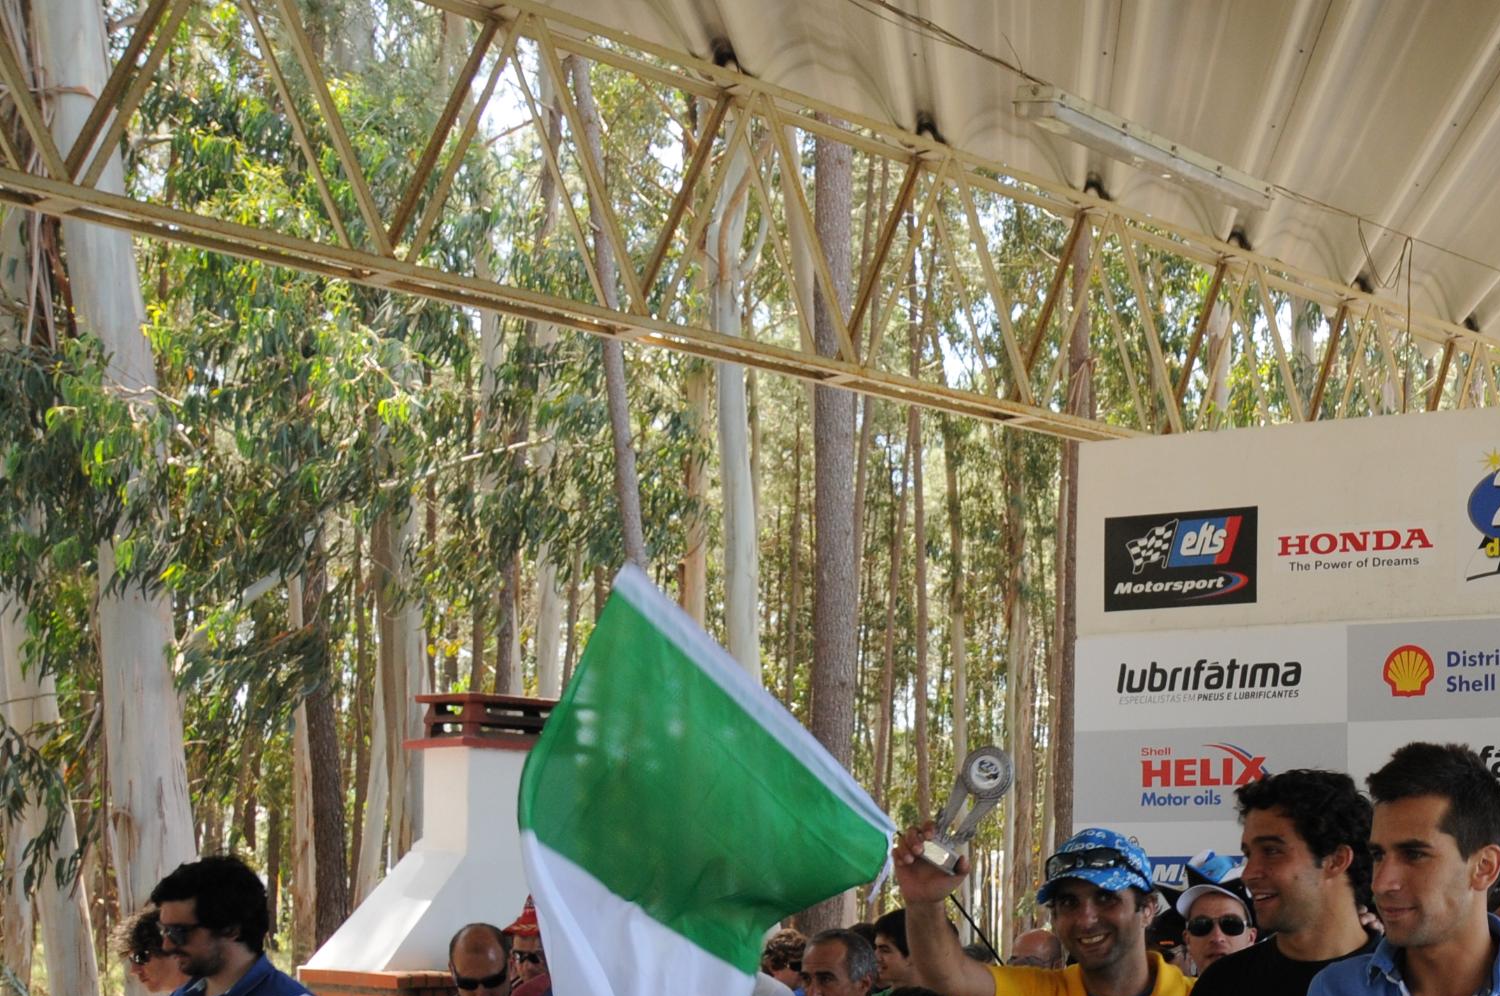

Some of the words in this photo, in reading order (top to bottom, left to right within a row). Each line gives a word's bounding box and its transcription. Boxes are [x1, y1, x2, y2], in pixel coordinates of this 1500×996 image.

[1277, 528, 1434, 556] HONDA
[1289, 561, 1311, 571] The
[1314, 559, 1352, 571] Power
[1356, 557, 1369, 568] of
[1372, 556, 1420, 567] Dreams
[1114, 574, 1225, 595] Motorsport
[1446, 674, 1495, 692] Shell
[1197, 692, 1224, 702] PNEUS
[1227, 691, 1232, 700] E
[1234, 689, 1299, 700] LUBRIFICANTES
[1141, 747, 1171, 756] Shell
[1141, 755, 1266, 788] HELIX
[1141, 792, 1190, 806] Motor
[1194, 789, 1221, 805] oils
